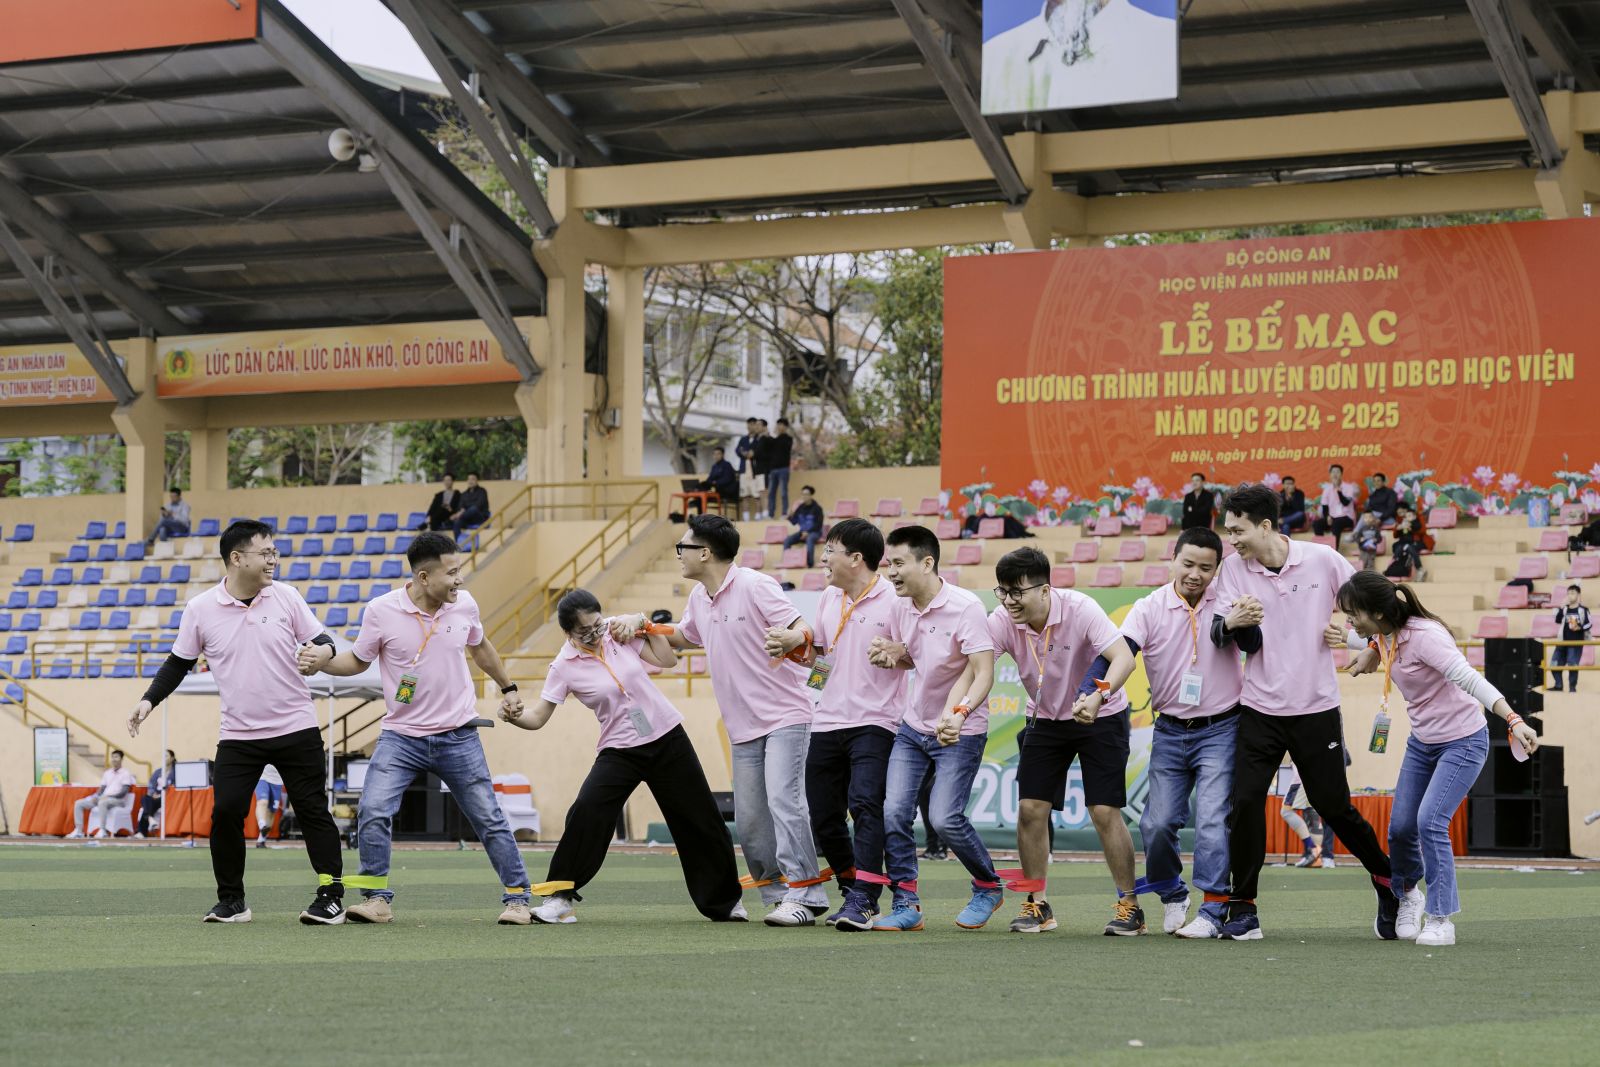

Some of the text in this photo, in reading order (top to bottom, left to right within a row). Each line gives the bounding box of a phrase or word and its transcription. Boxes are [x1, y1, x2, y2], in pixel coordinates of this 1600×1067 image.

[1225, 246, 1331, 269] BỘ CÔNG AN
[1159, 262, 1399, 295] HỌC VIỆN AN NINH NHÂN DÂN
[1159, 299, 1398, 357] LỄ BẾ MẠC
[7, 356, 19, 371] AN
[206, 348, 231, 376] LÚC
[235, 346, 262, 374] DÂN
[304, 344, 329, 371] LÚC
[333, 341, 361, 369] DÂN
[403, 336, 421, 366] CÓ
[425, 337, 464, 365] CÔNG
[469, 340, 489, 362] AN
[996, 348, 1575, 404] CHƯƠNG TRÌNH HUẤN LUYỆN ĐƠN VỊ DBCĐ HỌC VIỆN
[1154, 401, 1399, 439] NĂM HỌC 2024 - 2025
[1170, 450, 1188, 463] Hà
[1190, 449, 1214, 464] Nội,
[1215, 448, 1247, 464] ngày
[1266, 446, 1303, 462] tháng
[1304, 446, 1318, 458] 01
[1321, 444, 1349, 458] năm
[1351, 443, 1382, 457] 2025
[970, 766, 1087, 825] 205
